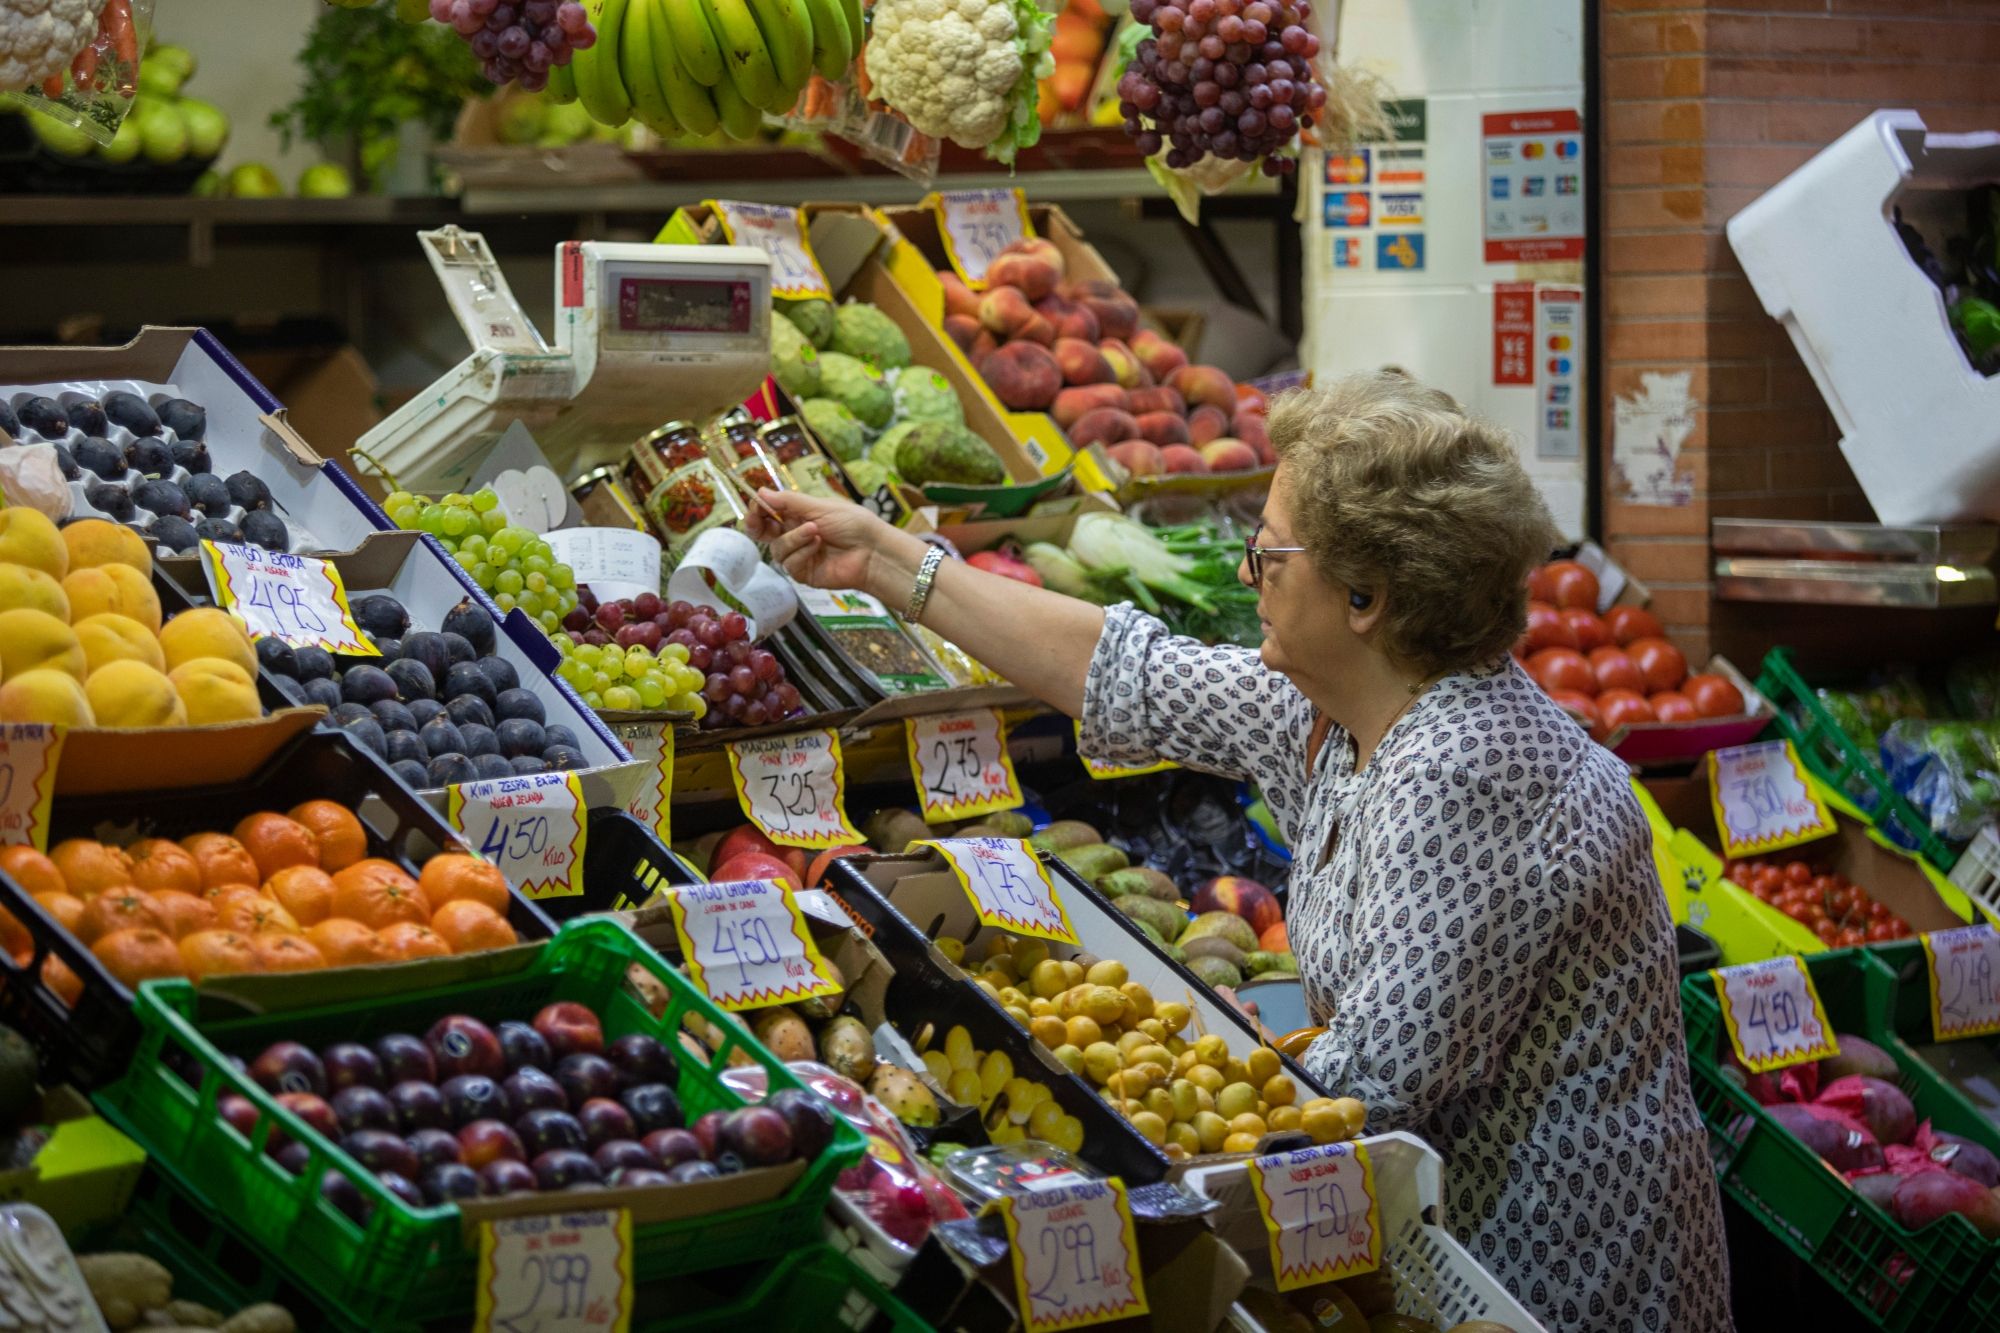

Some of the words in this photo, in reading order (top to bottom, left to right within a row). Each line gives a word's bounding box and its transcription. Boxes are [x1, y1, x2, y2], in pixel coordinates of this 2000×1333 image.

[228, 545, 262, 562] HIGO
[269, 552, 306, 569] EXTRA
[250, 575, 327, 637] 4'95
[741, 740, 788, 753] MANZANA
[794, 737, 821, 749] EXTRA
[470, 783, 493, 799] KIWI
[498, 779, 531, 793] ZESPRI
[535, 774, 563, 788] EXTRA
[490, 795, 513, 809] NUEVA
[629, 797, 649, 821] KILO
[760, 770, 817, 831] 3'25
[480, 816, 548, 866] 4'50
[543, 846, 565, 866] KILO
[688, 884, 722, 902] HIGO
[726, 881, 767, 898] CHUMBO
[713, 916, 781, 986] 4'50
[784, 958, 805, 977] KILO
[1260, 1156, 1284, 1171] KIWI
[1288, 1148, 1321, 1165] ZESPRI
[1322, 1143, 1347, 1158] GOLD
[1018, 1188, 1068, 1211] CIRUELA
[1283, 1182, 1349, 1264] 7'50
[1349, 1215, 1365, 1248] KILO
